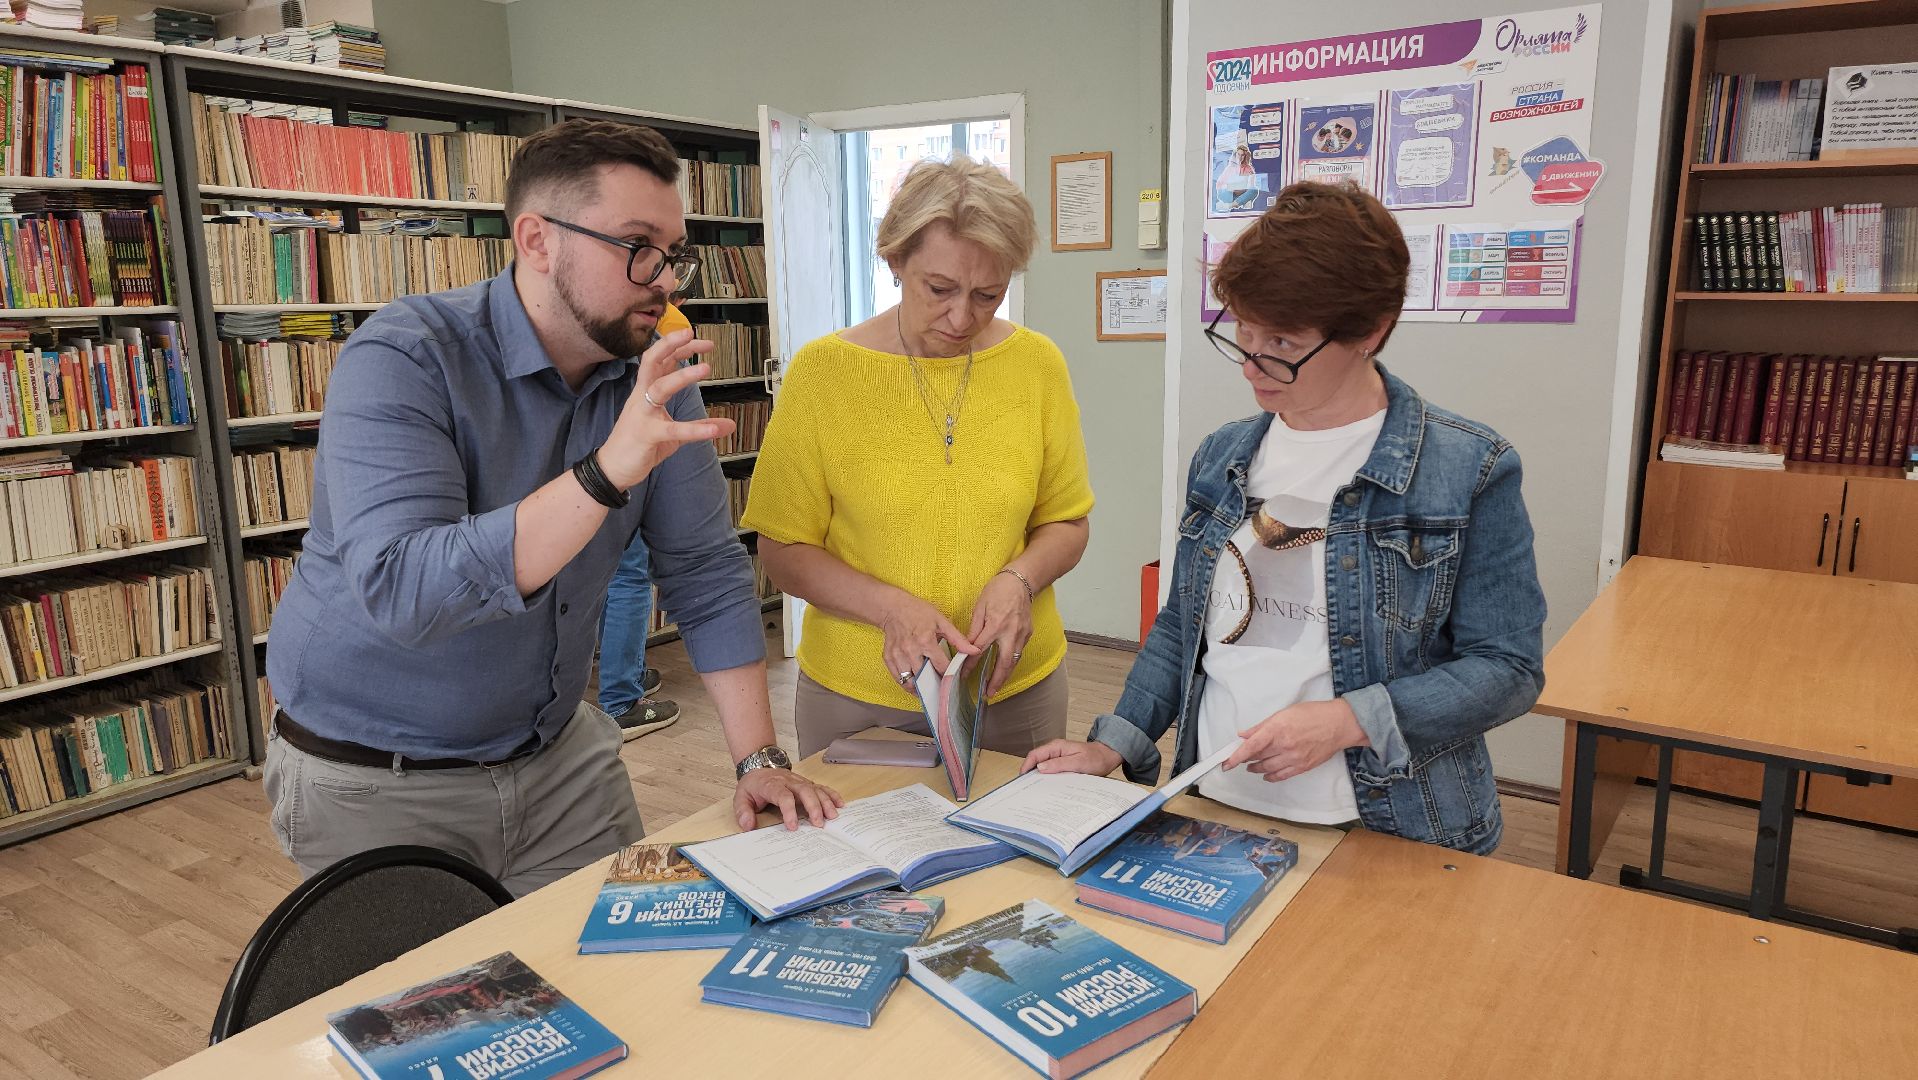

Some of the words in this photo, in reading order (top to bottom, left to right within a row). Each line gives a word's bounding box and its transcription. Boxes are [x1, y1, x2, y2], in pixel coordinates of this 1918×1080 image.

[1252, 33, 1425, 76] ИНФОРМАЦИЯ
[1513, 42, 1571, 57] РОССИИ
[1214, 59, 1251, 83] 2024
[1511, 82, 1554, 95] РОССИЯ
[1518, 93, 1559, 107] СТРАНА
[1492, 99, 1580, 121] ВОЗМОЖНОСТЕЙ
[1523, 152, 1581, 164] #КОМАНДА
[1141, 192, 1154, 200] 220
[112, 530, 119, 543] Б
[1100, 860, 1143, 884] 11
[1148, 869, 1228, 898] РОССИИ
[653, 899, 725, 910] СРЕДНИХ
[677, 891, 726, 901] ВЕКОВ
[1140, 880, 1219, 908] ИСТОРИЯ
[607, 901, 634, 925] 6
[634, 907, 722, 923] ИСТОРИЯ
[729, 948, 778, 978] 11
[784, 954, 872, 978] ИСТОРИЯ
[775, 967, 863, 990] ВСЕОБЩАЯ
[1055, 964, 1138, 1008] РОССИИ
[1075, 976, 1156, 1019] ИСТОРИЯ
[1016, 999, 1078, 1037] 10
[455, 1021, 559, 1070] РОССИИ
[467, 1032, 572, 1080] ИСТОРИЯ
